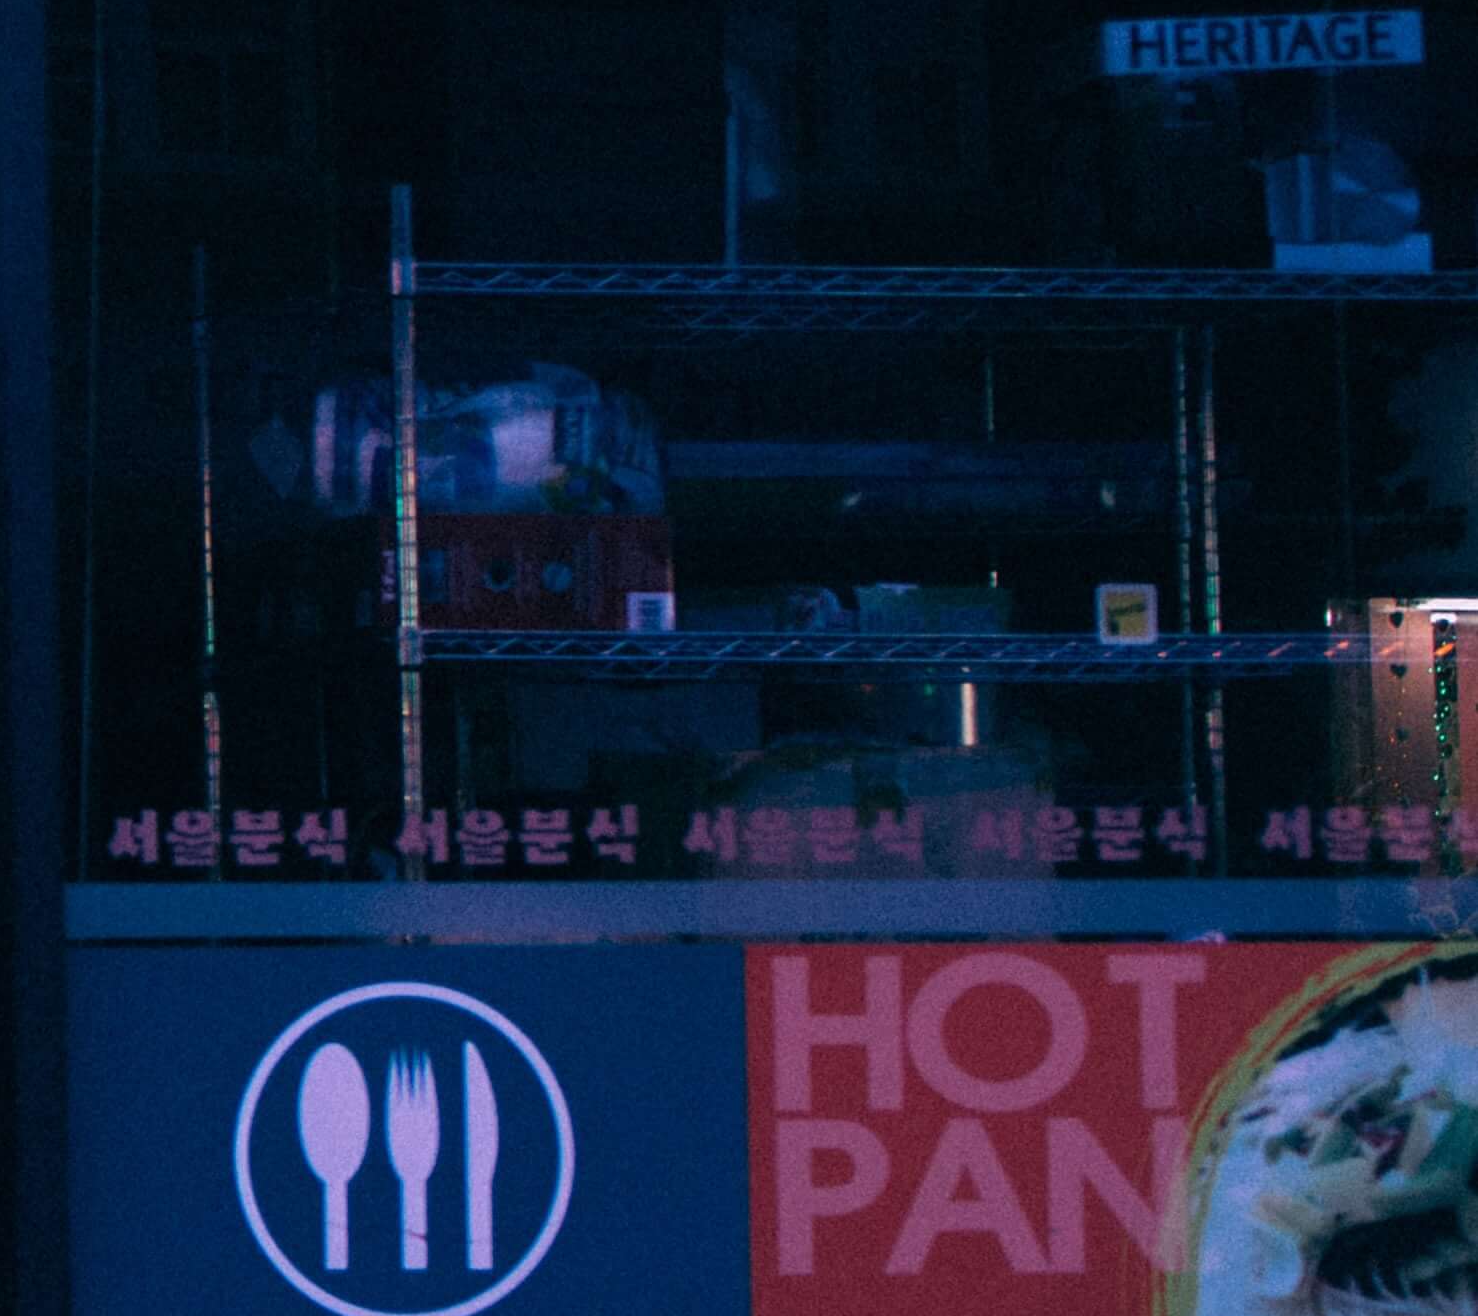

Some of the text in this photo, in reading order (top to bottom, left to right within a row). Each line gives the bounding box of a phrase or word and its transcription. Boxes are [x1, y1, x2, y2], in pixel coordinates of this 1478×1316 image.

[1130, 14, 1397, 68] HERITAGE
[108, 808, 346, 865] 서울분식
[396, 804, 638, 865] 서울분식
[683, 806, 923, 863] 서울분식
[971, 805, 1206, 861] 서울분식
[771, 950, 1206, 1112] HOT
[775, 1116, 1187, 1277] PAN
